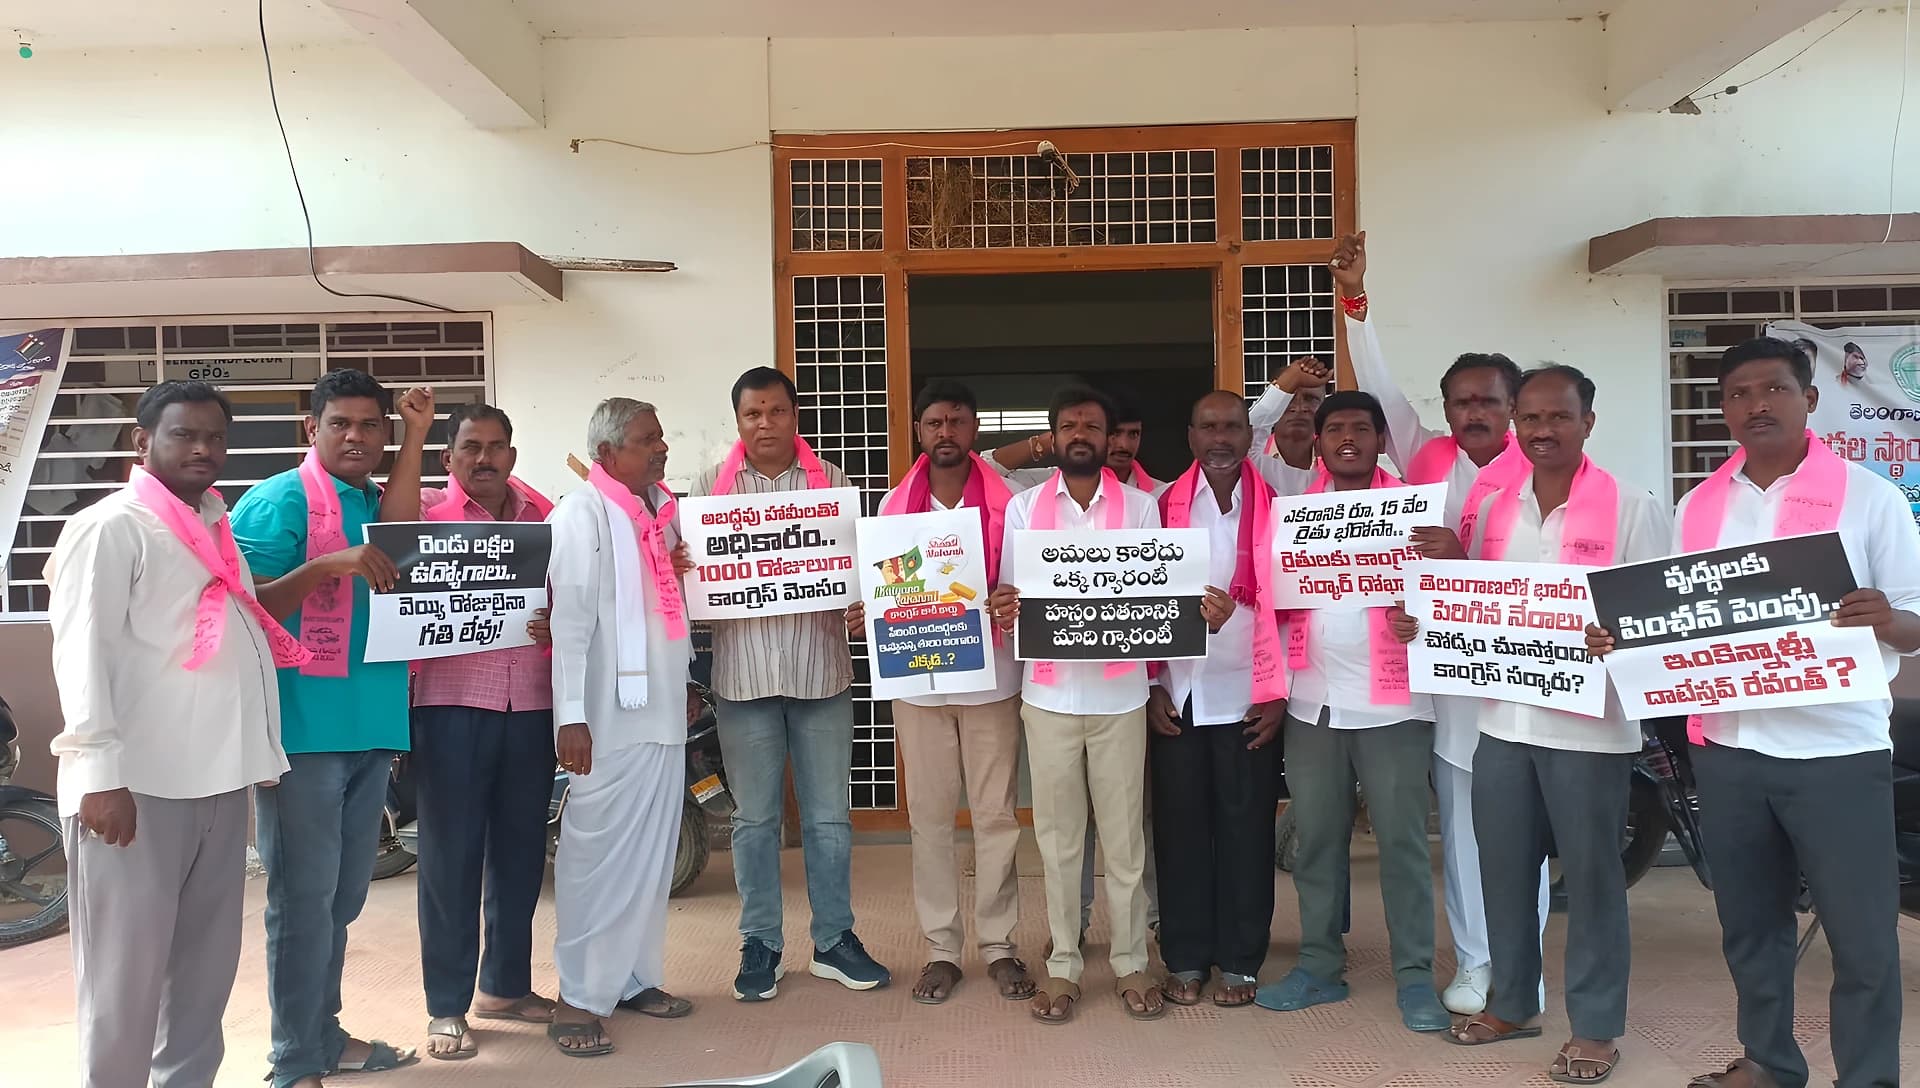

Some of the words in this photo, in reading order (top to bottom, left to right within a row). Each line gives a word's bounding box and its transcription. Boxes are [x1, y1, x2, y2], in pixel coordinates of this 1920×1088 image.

[764, 502, 840, 521] హామీలతో
[1283, 503, 1345, 524] ఎకరానికి
[1348, 502, 1374, 519] రూ.
[1380, 500, 1399, 516] 15
[1401, 494, 1428, 514] వేల
[706, 523, 836, 560] అధికారం..
[1292, 524, 1331, 544] రైతు
[1333, 519, 1404, 543] భరోసా..
[418, 534, 469, 554] రెండు
[473, 534, 515, 561] లక్షల
[1041, 543, 1111, 563] అమలు
[1115, 537, 1184, 563] కాలేదు
[1280, 549, 1351, 573] రైతులకు
[409, 559, 517, 589] ఉద్యోగాలు..
[696, 562, 752, 582] 1000
[757, 555, 853, 578] రోజులుగా
[1053, 570, 1091, 594] ఒక్క
[1093, 562, 1169, 595] గ్యారంటీ
[1663, 552, 1770, 596] వృద్ధులకు
[707, 582, 778, 610] కాంగ్రెస్
[783, 578, 847, 601] మోసం
[1299, 573, 1354, 600] సర్కార్
[1419, 574, 1530, 596] తెలంగాణలో
[399, 597, 446, 620] వెయ్యి
[450, 593, 526, 616] రోజులైనా
[1044, 603, 1097, 629] హస్తం
[1100, 598, 1181, 622] పతనానికి
[1432, 599, 1502, 625] పెరిగిన
[1507, 600, 1584, 632] నేరాలు
[1618, 599, 1723, 641] పింఛన్
[1729, 586, 1840, 624] పెంపు..
[418, 623, 454, 646] గతి
[458, 615, 504, 644] లేవు!
[1052, 628, 1099, 647] మాది
[1102, 620, 1174, 654] గ్యారంటీ
[1424, 630, 1487, 657] చోద్యం
[908, 652, 956, 671] ఎక్కడ..?
[1662, 630, 1817, 670] ఇంకెన్నాళ్లు
[1433, 662, 1502, 686] కాంగ్రెస్
[1507, 666, 1585, 697] సర్కారు?
[1643, 676, 1738, 707] దాటేస్తవ్
